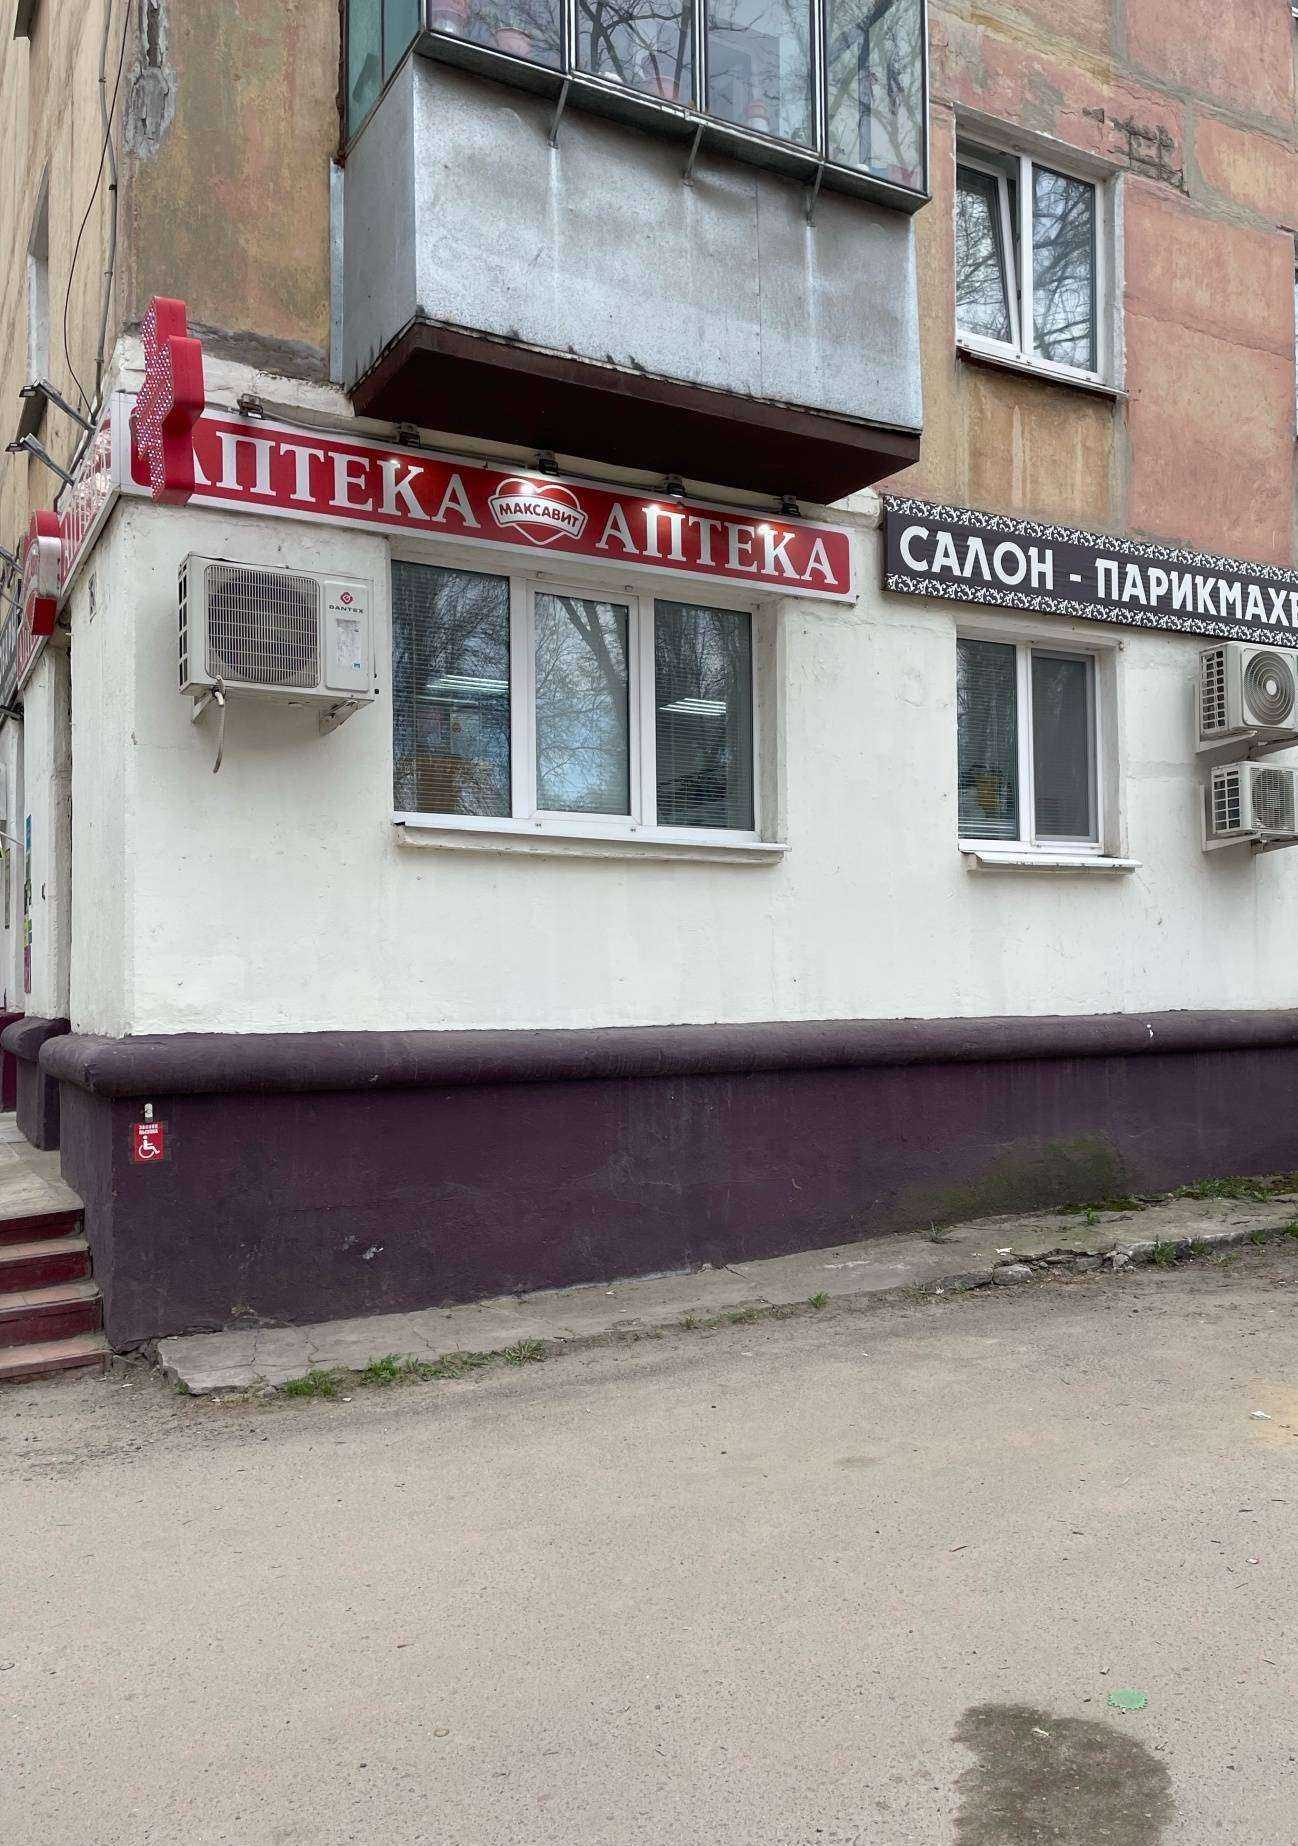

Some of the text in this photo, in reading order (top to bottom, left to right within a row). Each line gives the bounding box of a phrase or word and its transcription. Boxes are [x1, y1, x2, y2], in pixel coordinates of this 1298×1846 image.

[498, 502, 580, 529] МАКСАВИТ
[595, 502, 837, 585] АПТЕКА
[899, 525, 1054, 590] САЛОН
[1069, 574, 1082, 582] -
[328, 604, 364, 614] DANTEX
